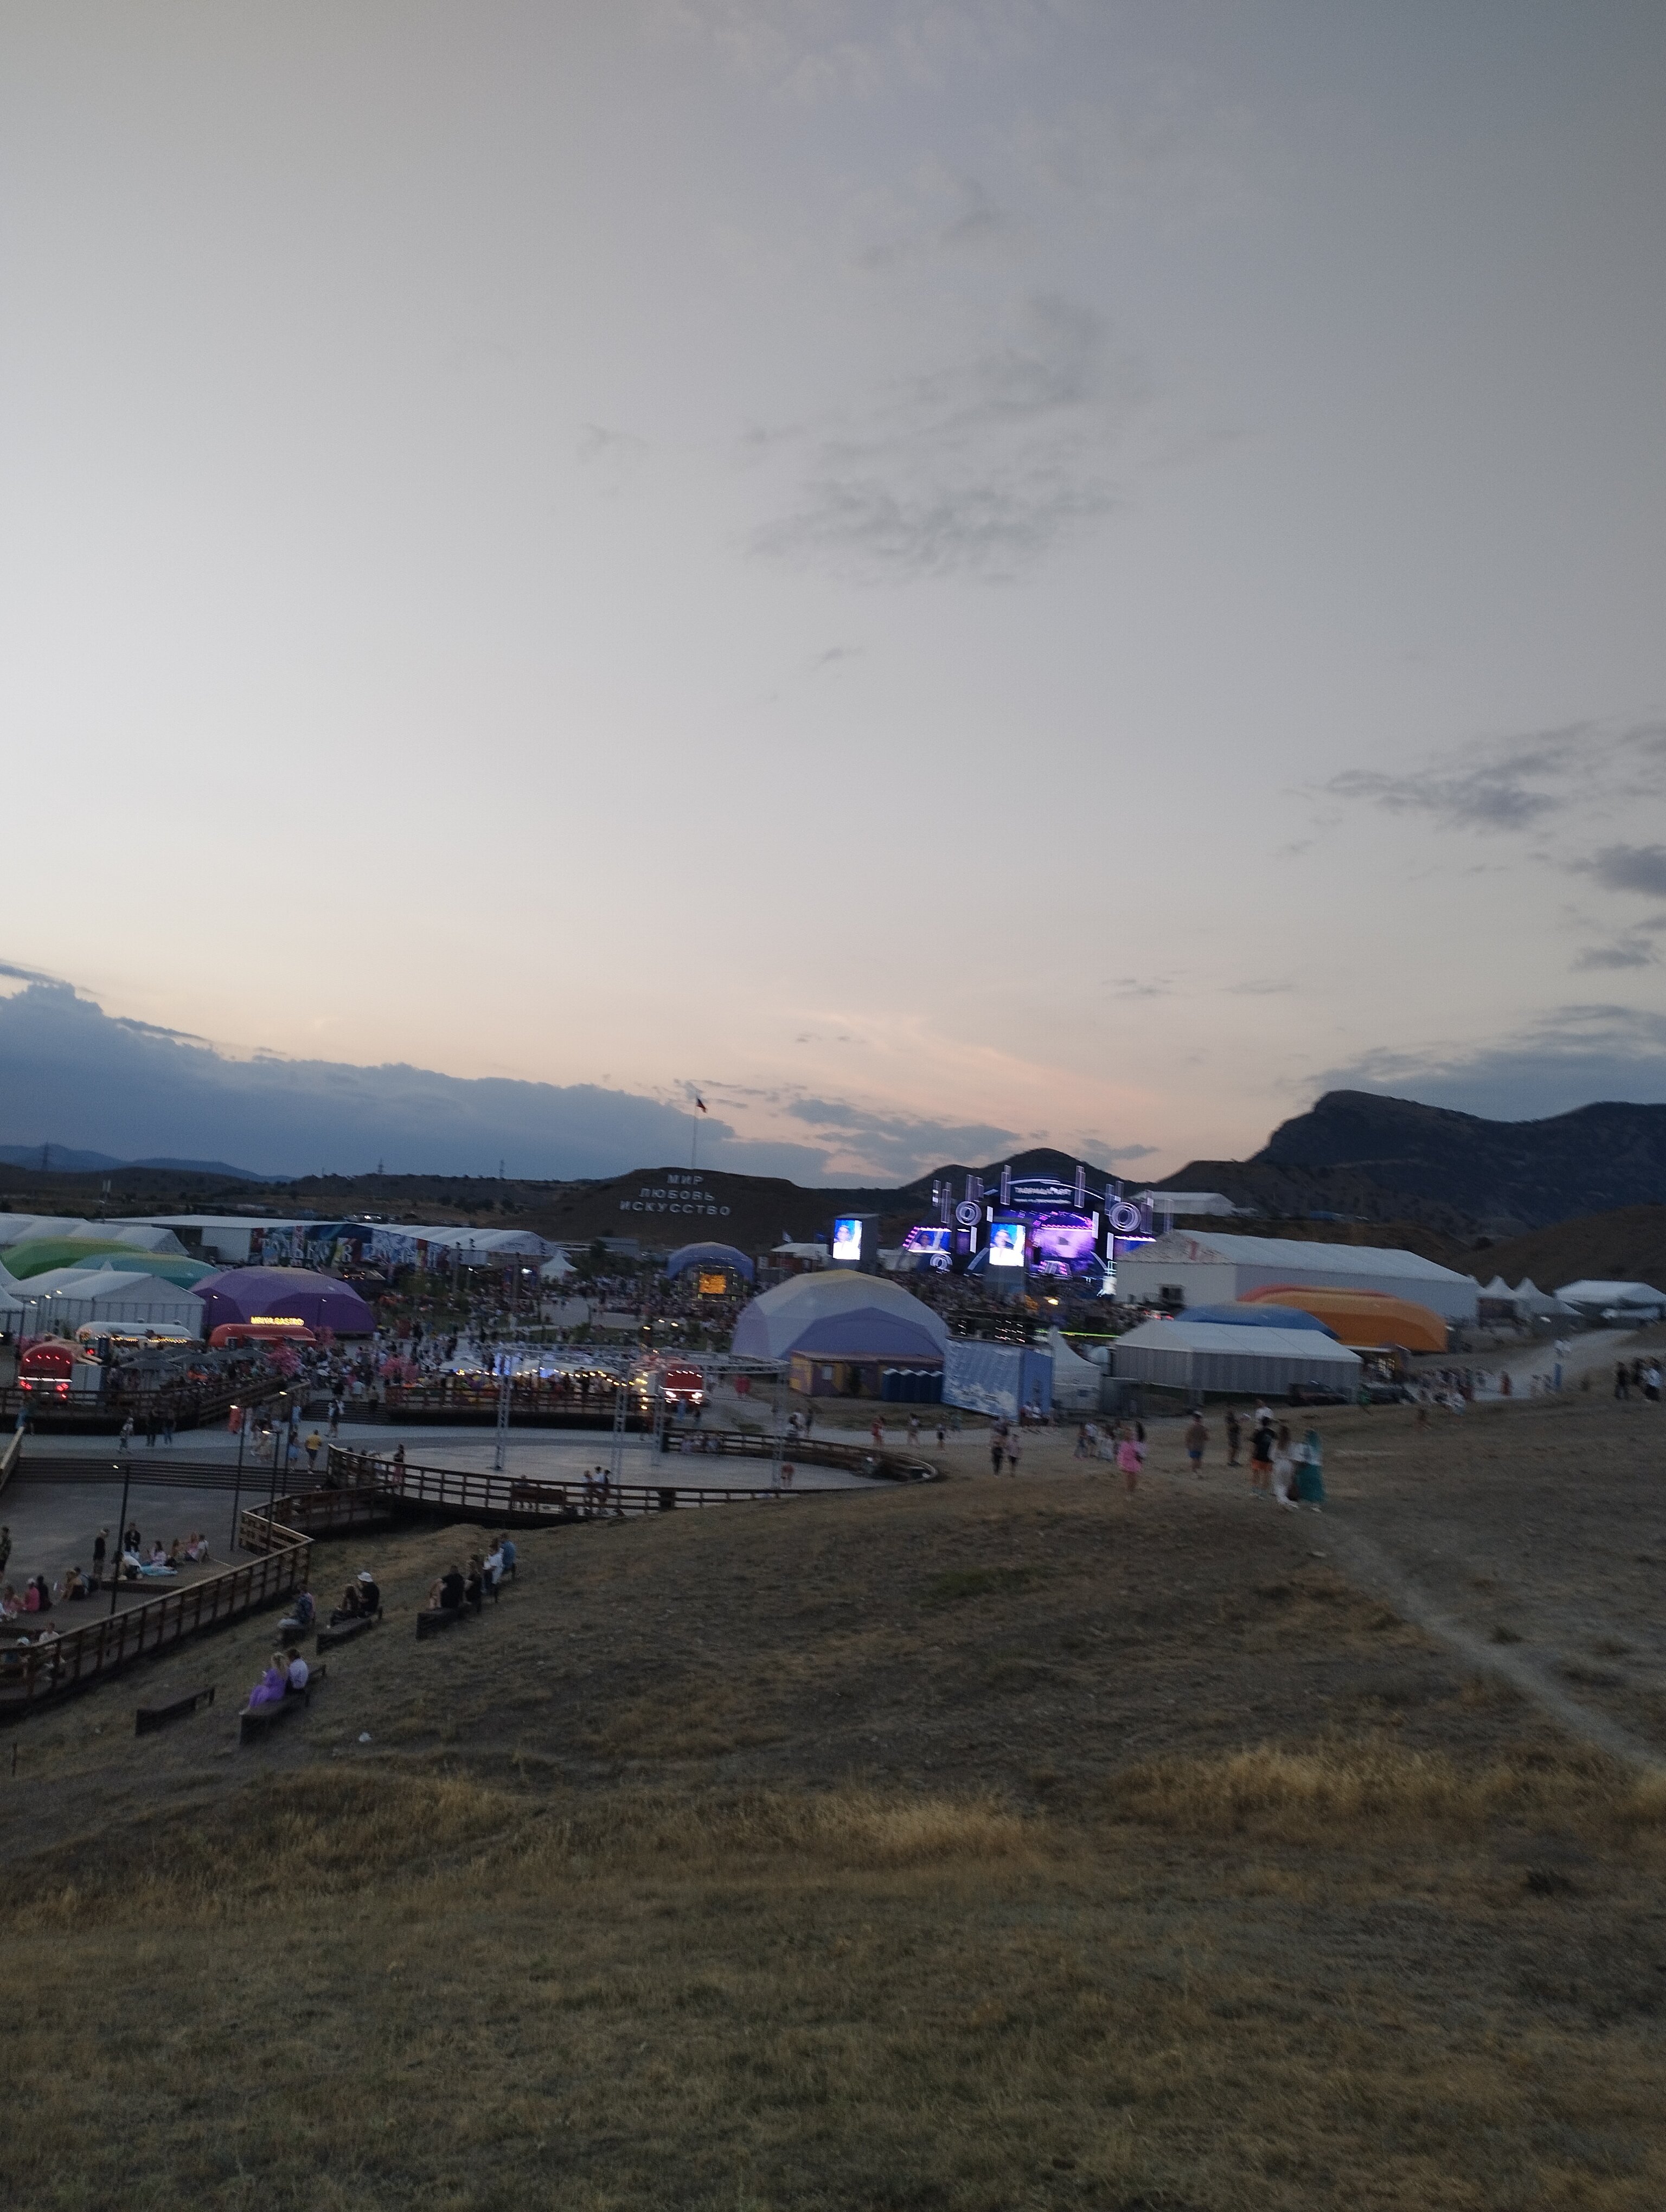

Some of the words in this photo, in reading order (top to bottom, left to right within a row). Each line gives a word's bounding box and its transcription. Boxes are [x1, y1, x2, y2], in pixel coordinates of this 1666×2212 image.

[667, 1174, 703, 1185] МИР
[639, 1188, 715, 1201] ЛЮБОВЬ
[620, 1200, 731, 1216] ИСКУССТВО
